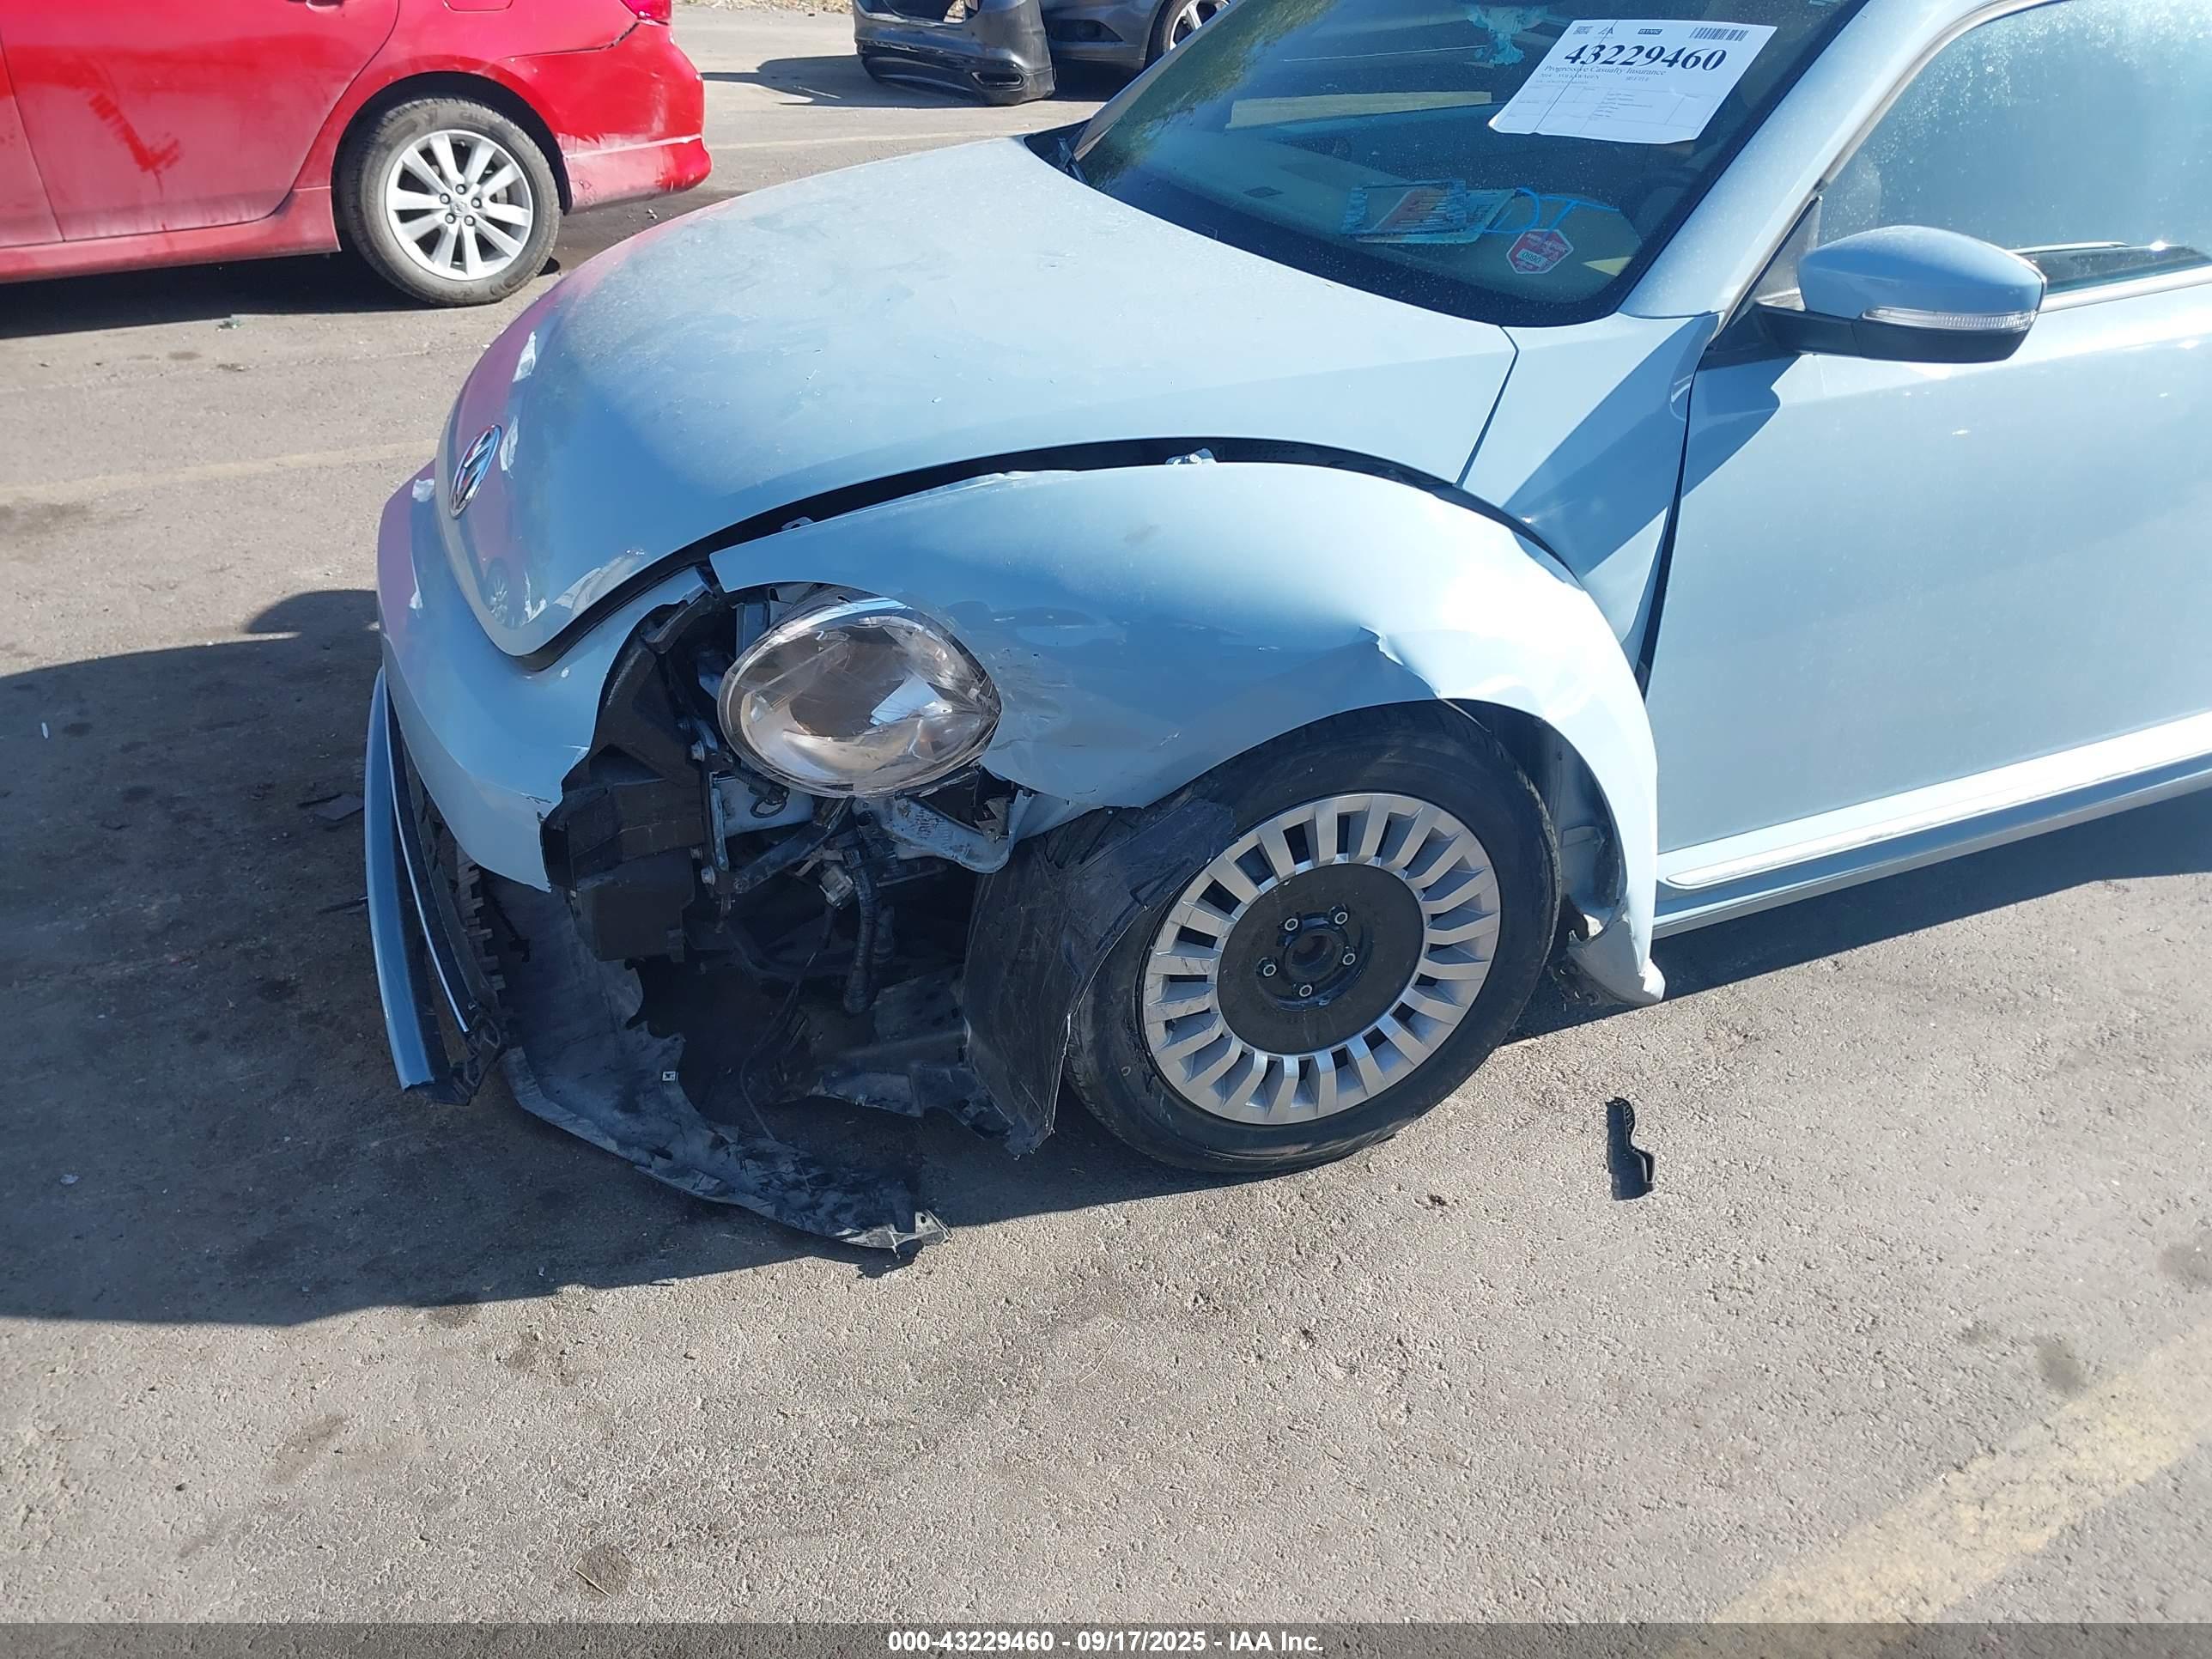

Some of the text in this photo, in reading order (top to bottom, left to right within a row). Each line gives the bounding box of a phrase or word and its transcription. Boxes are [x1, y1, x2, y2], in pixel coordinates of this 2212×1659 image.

[1564, 44, 1727, 70] 43229460
[1590, 65, 1623, 76] Casualty
[1626, 67, 1667, 76] Insurance
